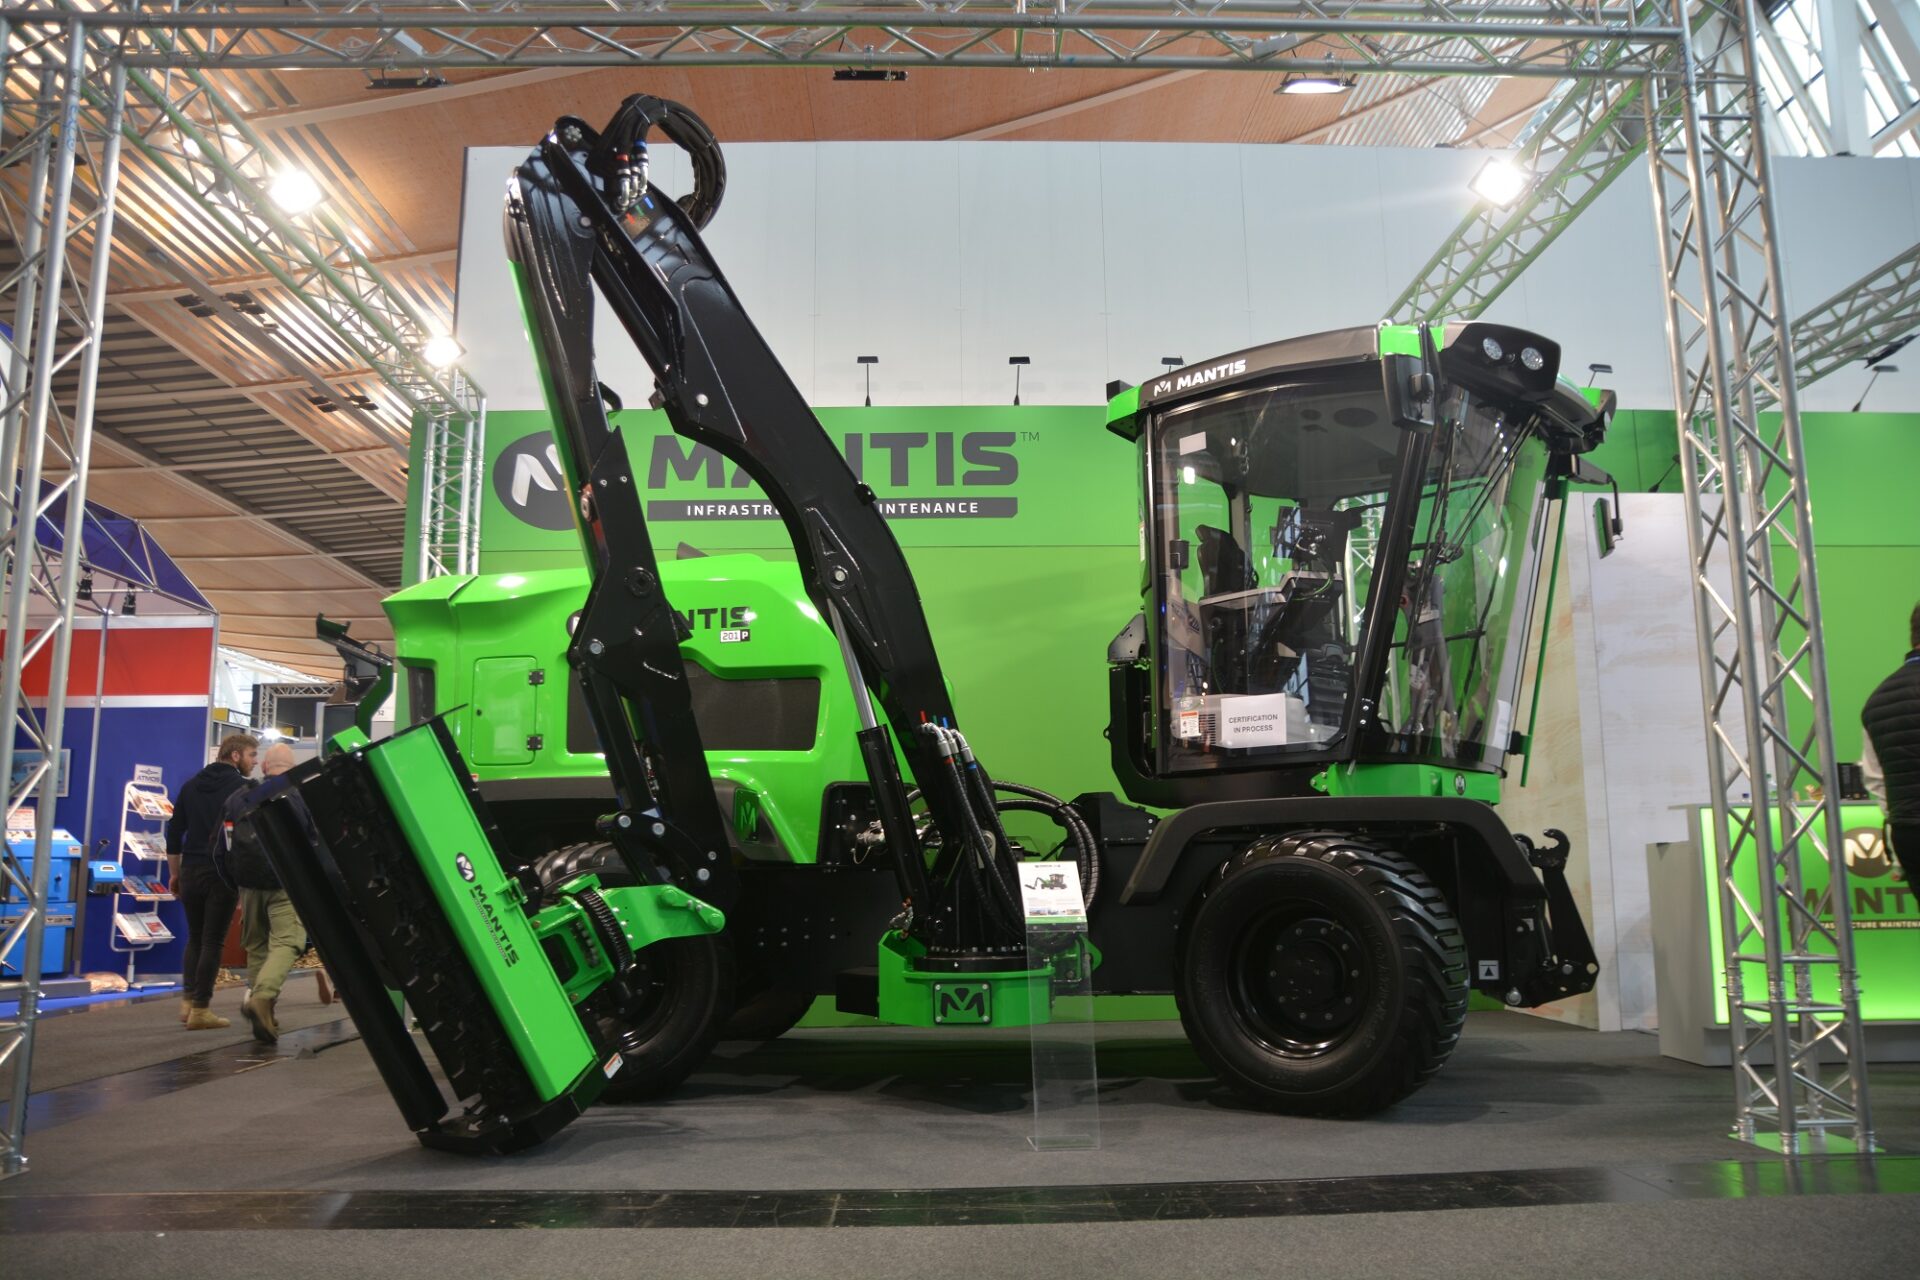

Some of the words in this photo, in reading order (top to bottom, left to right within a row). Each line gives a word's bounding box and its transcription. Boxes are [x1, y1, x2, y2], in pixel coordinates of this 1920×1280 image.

[1176, 359, 1247, 391] MANTIS
[647, 431, 1019, 489] MTIS
[878, 501, 979, 515] INTENANCE
[1228, 713, 1279, 724] CERTIFICATION
[1242, 724, 1274, 733] PROCESS
[473, 884, 520, 965] MANTIS
